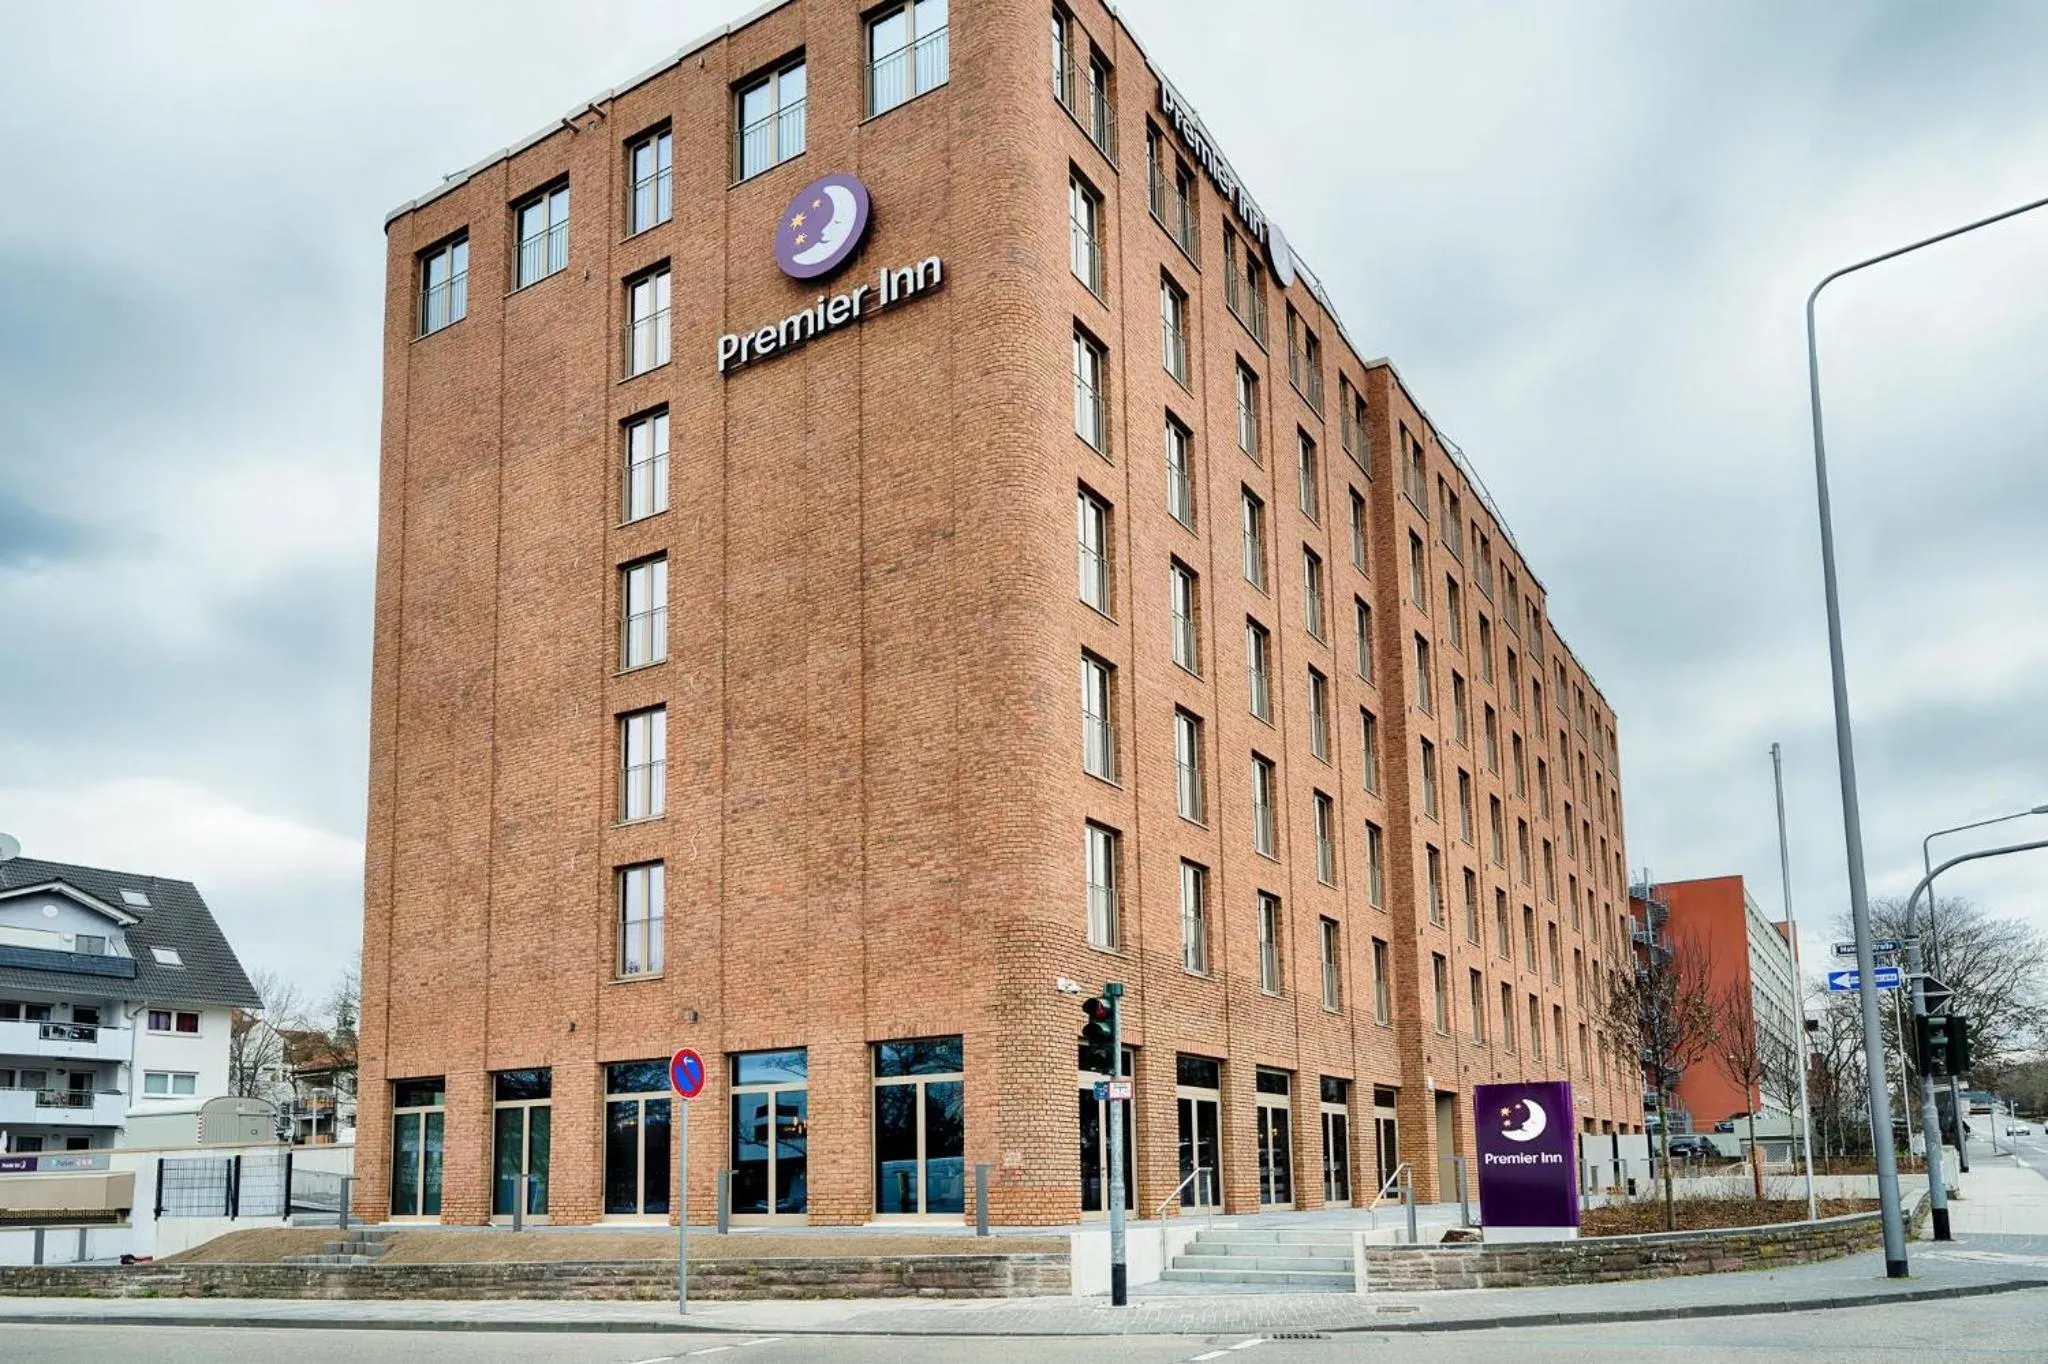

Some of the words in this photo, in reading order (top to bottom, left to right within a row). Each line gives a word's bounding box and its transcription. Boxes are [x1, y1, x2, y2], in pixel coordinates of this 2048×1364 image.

[1161, 84, 1236, 201] Premier
[1238, 187, 1265, 244] Inn
[718, 284, 869, 372] Premier
[879, 255, 942, 306] Inn
[1485, 1152, 1539, 1165] Premier
[1541, 1152, 1563, 1164] Inn
